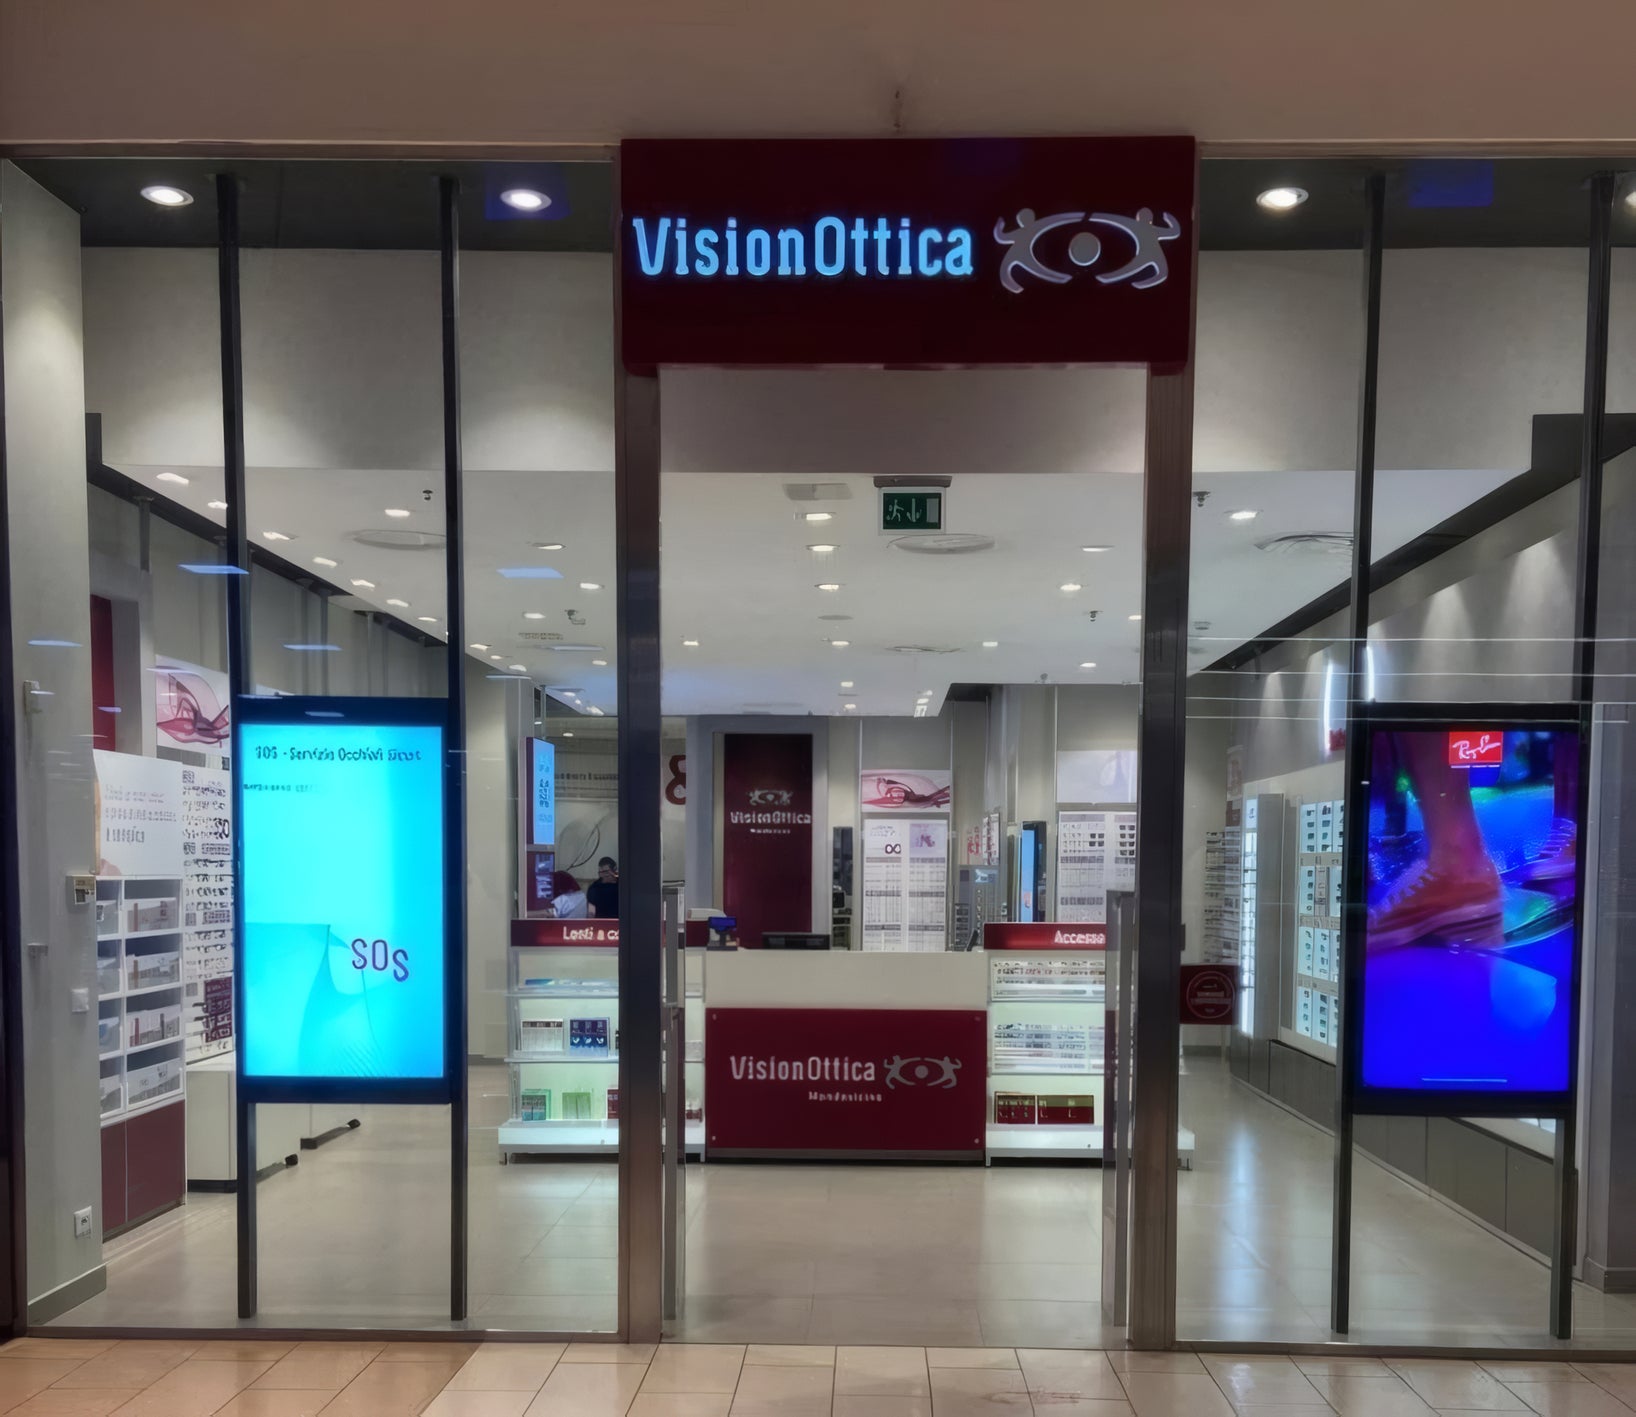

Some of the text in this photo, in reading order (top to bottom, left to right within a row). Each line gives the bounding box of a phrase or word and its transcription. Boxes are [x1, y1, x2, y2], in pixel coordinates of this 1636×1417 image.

[632, 216, 974, 276] VisionOttica
[351, 938, 409, 983] SOS
[730, 1056, 876, 1081] VisionOttica
